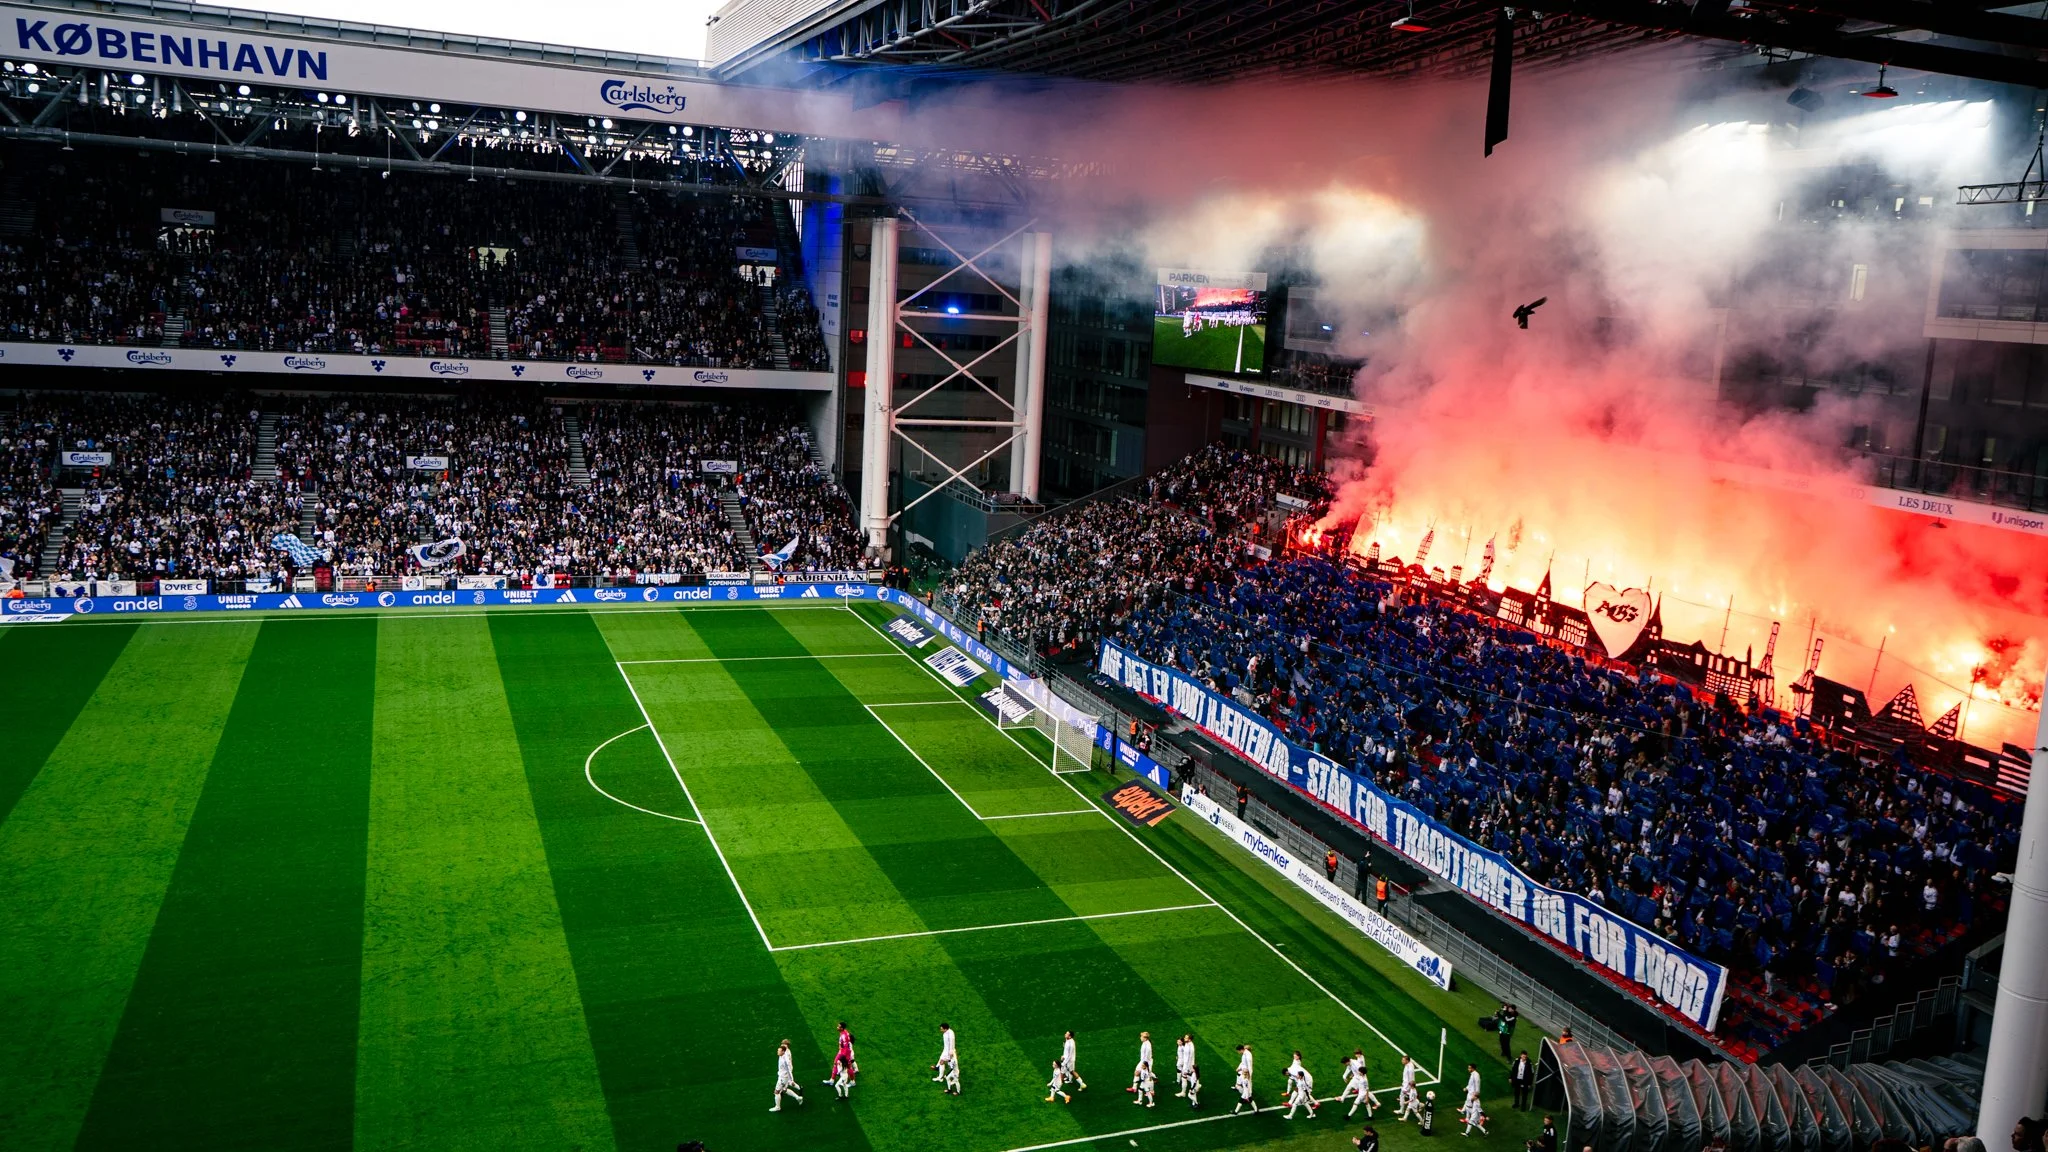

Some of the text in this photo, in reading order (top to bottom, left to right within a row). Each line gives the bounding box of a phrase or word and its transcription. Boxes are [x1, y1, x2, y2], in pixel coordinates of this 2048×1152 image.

[16, 18, 327, 80] KØBENHAVN
[601, 79, 687, 114] Carlsberg
[1169, 273, 1210, 283] PARKEN
[126, 350, 172, 365] Carlsberg
[284, 356, 326, 370] Carlsberg
[430, 361, 469, 375] Carlsberg
[566, 366, 603, 379] Carlsberg
[694, 370, 729, 383] Carlsberg
[70, 453, 104, 464] Carlsberg
[413, 457, 442, 467] Carlsberg
[706, 461, 732, 471] Carlsberg
[1899, 496, 1954, 515] LES DEUX
[2003, 515, 2045, 529] unisport
[165, 583, 203, 591] ØVRE C
[674, 587, 712, 600] andel
[754, 586, 785, 594] UNIBET
[835, 585, 865, 596] Carlsberg
[218, 595, 258, 604] UNIBET
[322, 593, 360, 606] Carlsberg
[413, 591, 456, 604] andel
[503, 590, 539, 599] UNIBET
[594, 589, 627, 601] Carlsberg
[8, 600, 51, 613] Carlsberg
[113, 597, 163, 611] andel
[976, 647, 993, 664] andel
[1119, 741, 1141, 762] UNIBET
[1112, 785, 1169, 819] expekt
[1100, 644, 1122, 681] AGF
[1124, 656, 1148, 693] DET
[1152, 667, 1170, 705] ER
[1172, 677, 1206, 724] VORT
[1206, 697, 1289, 781] HJERTEBLOD
[1307, 757, 1352, 817] STÅR
[1355, 783, 1388, 841] FOR
[1393, 808, 1527, 921] TRADITIONER
[1532, 888, 1568, 945] OG
[1574, 903, 1627, 976] FOR
[1634, 932, 1709, 1023] MOD
[1244, 830, 1289, 870] mybanker
[1297, 868, 1366, 926] Anders Andersen's Rengøring
[1366, 923, 1402, 955] SJÆLLAND
[1367, 912, 1418, 953] BROLÆGNING
